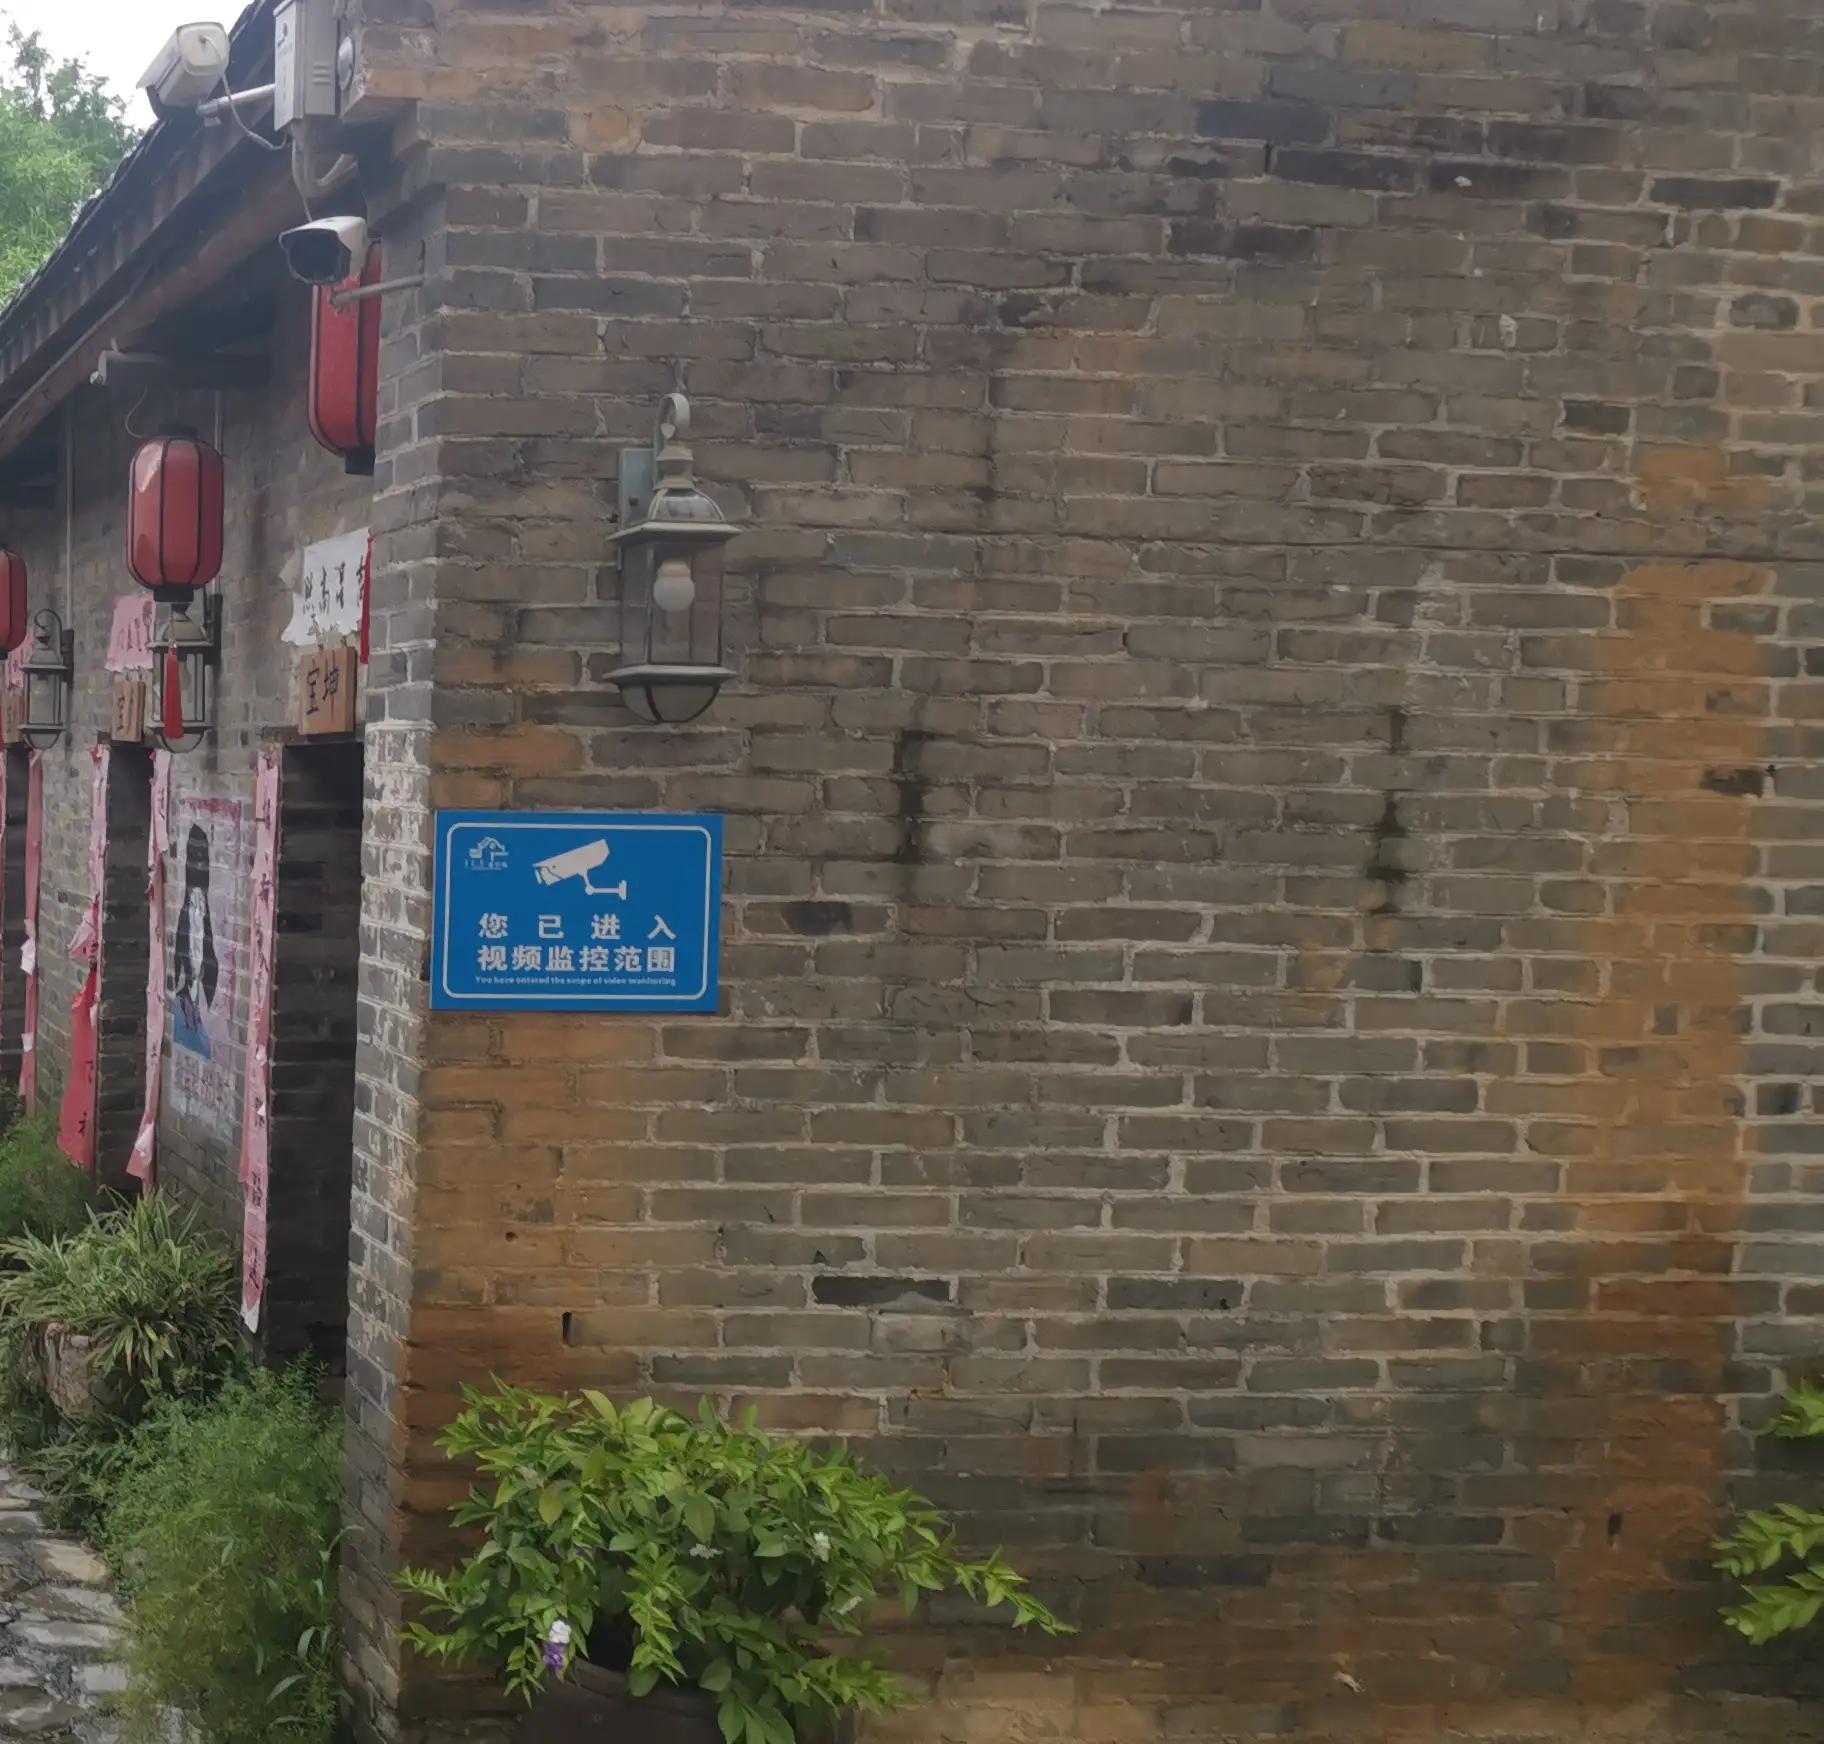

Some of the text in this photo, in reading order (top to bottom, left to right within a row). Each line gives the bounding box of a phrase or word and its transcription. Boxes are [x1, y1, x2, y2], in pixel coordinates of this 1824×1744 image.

[478, 913, 677, 940] 您已进入
[477, 945, 676, 973] 视频监控范围
